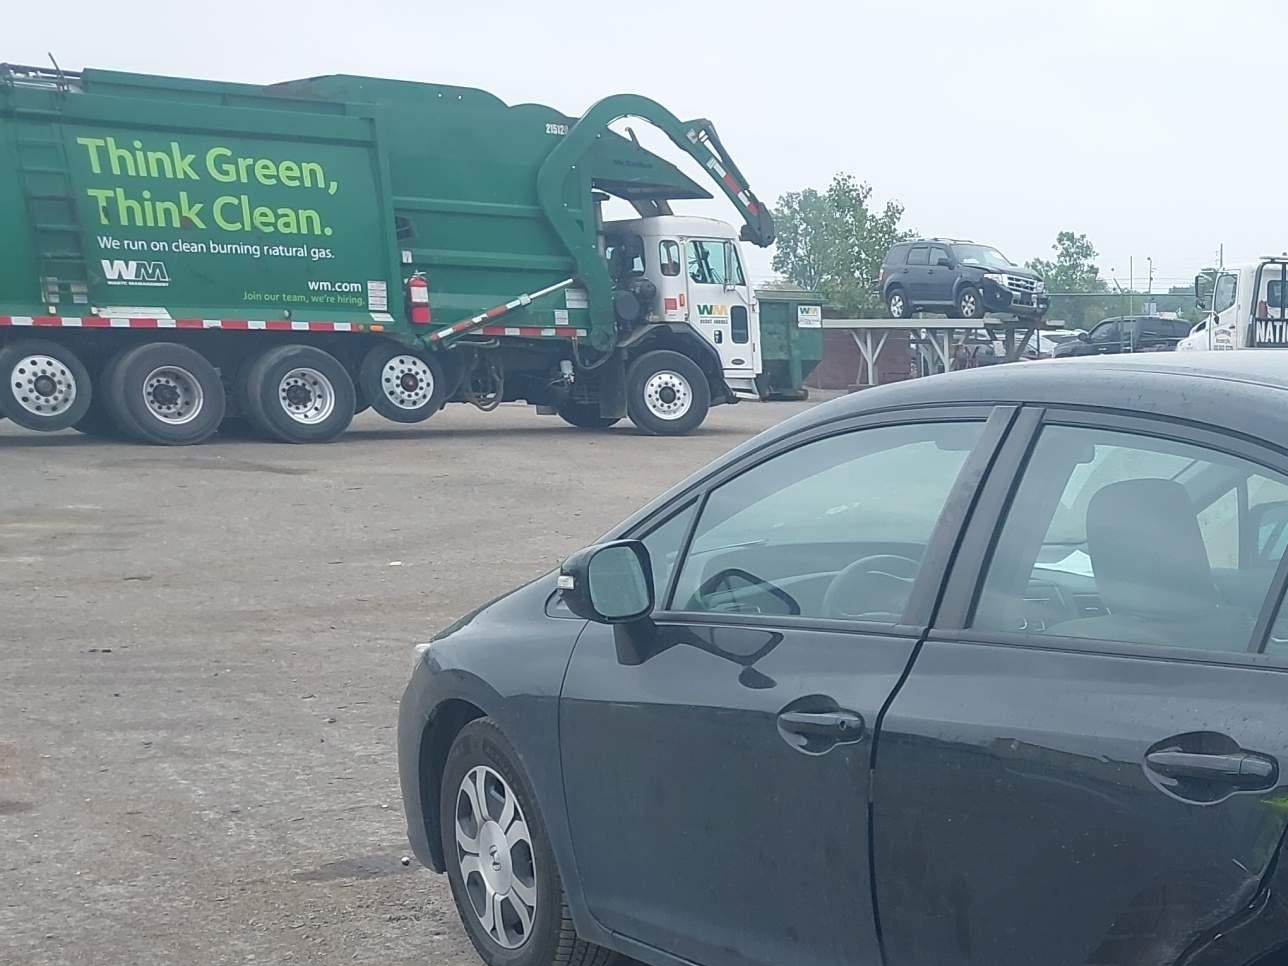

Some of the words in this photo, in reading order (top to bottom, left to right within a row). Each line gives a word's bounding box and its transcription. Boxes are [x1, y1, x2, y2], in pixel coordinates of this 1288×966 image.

[76, 136, 200, 180] Think
[206, 146, 338, 195] Green,
[87, 187, 207, 229] Think
[213, 194, 333, 236] Clean.
[97, 236, 120, 250] We
[124, 240, 147, 251] run
[150, 241, 168, 252] on
[172, 239, 206, 253] clean
[210, 240, 260, 258] burning
[310, 247, 335, 261] gas.
[101, 259, 169, 281] WM
[308, 280, 362, 292] wm.com
[242, 291, 262, 301] Join
[264, 293, 280, 301] our
[282, 293, 309, 303] team,
[310, 294, 335, 303] we're
[337, 294, 366, 307] hiring.
